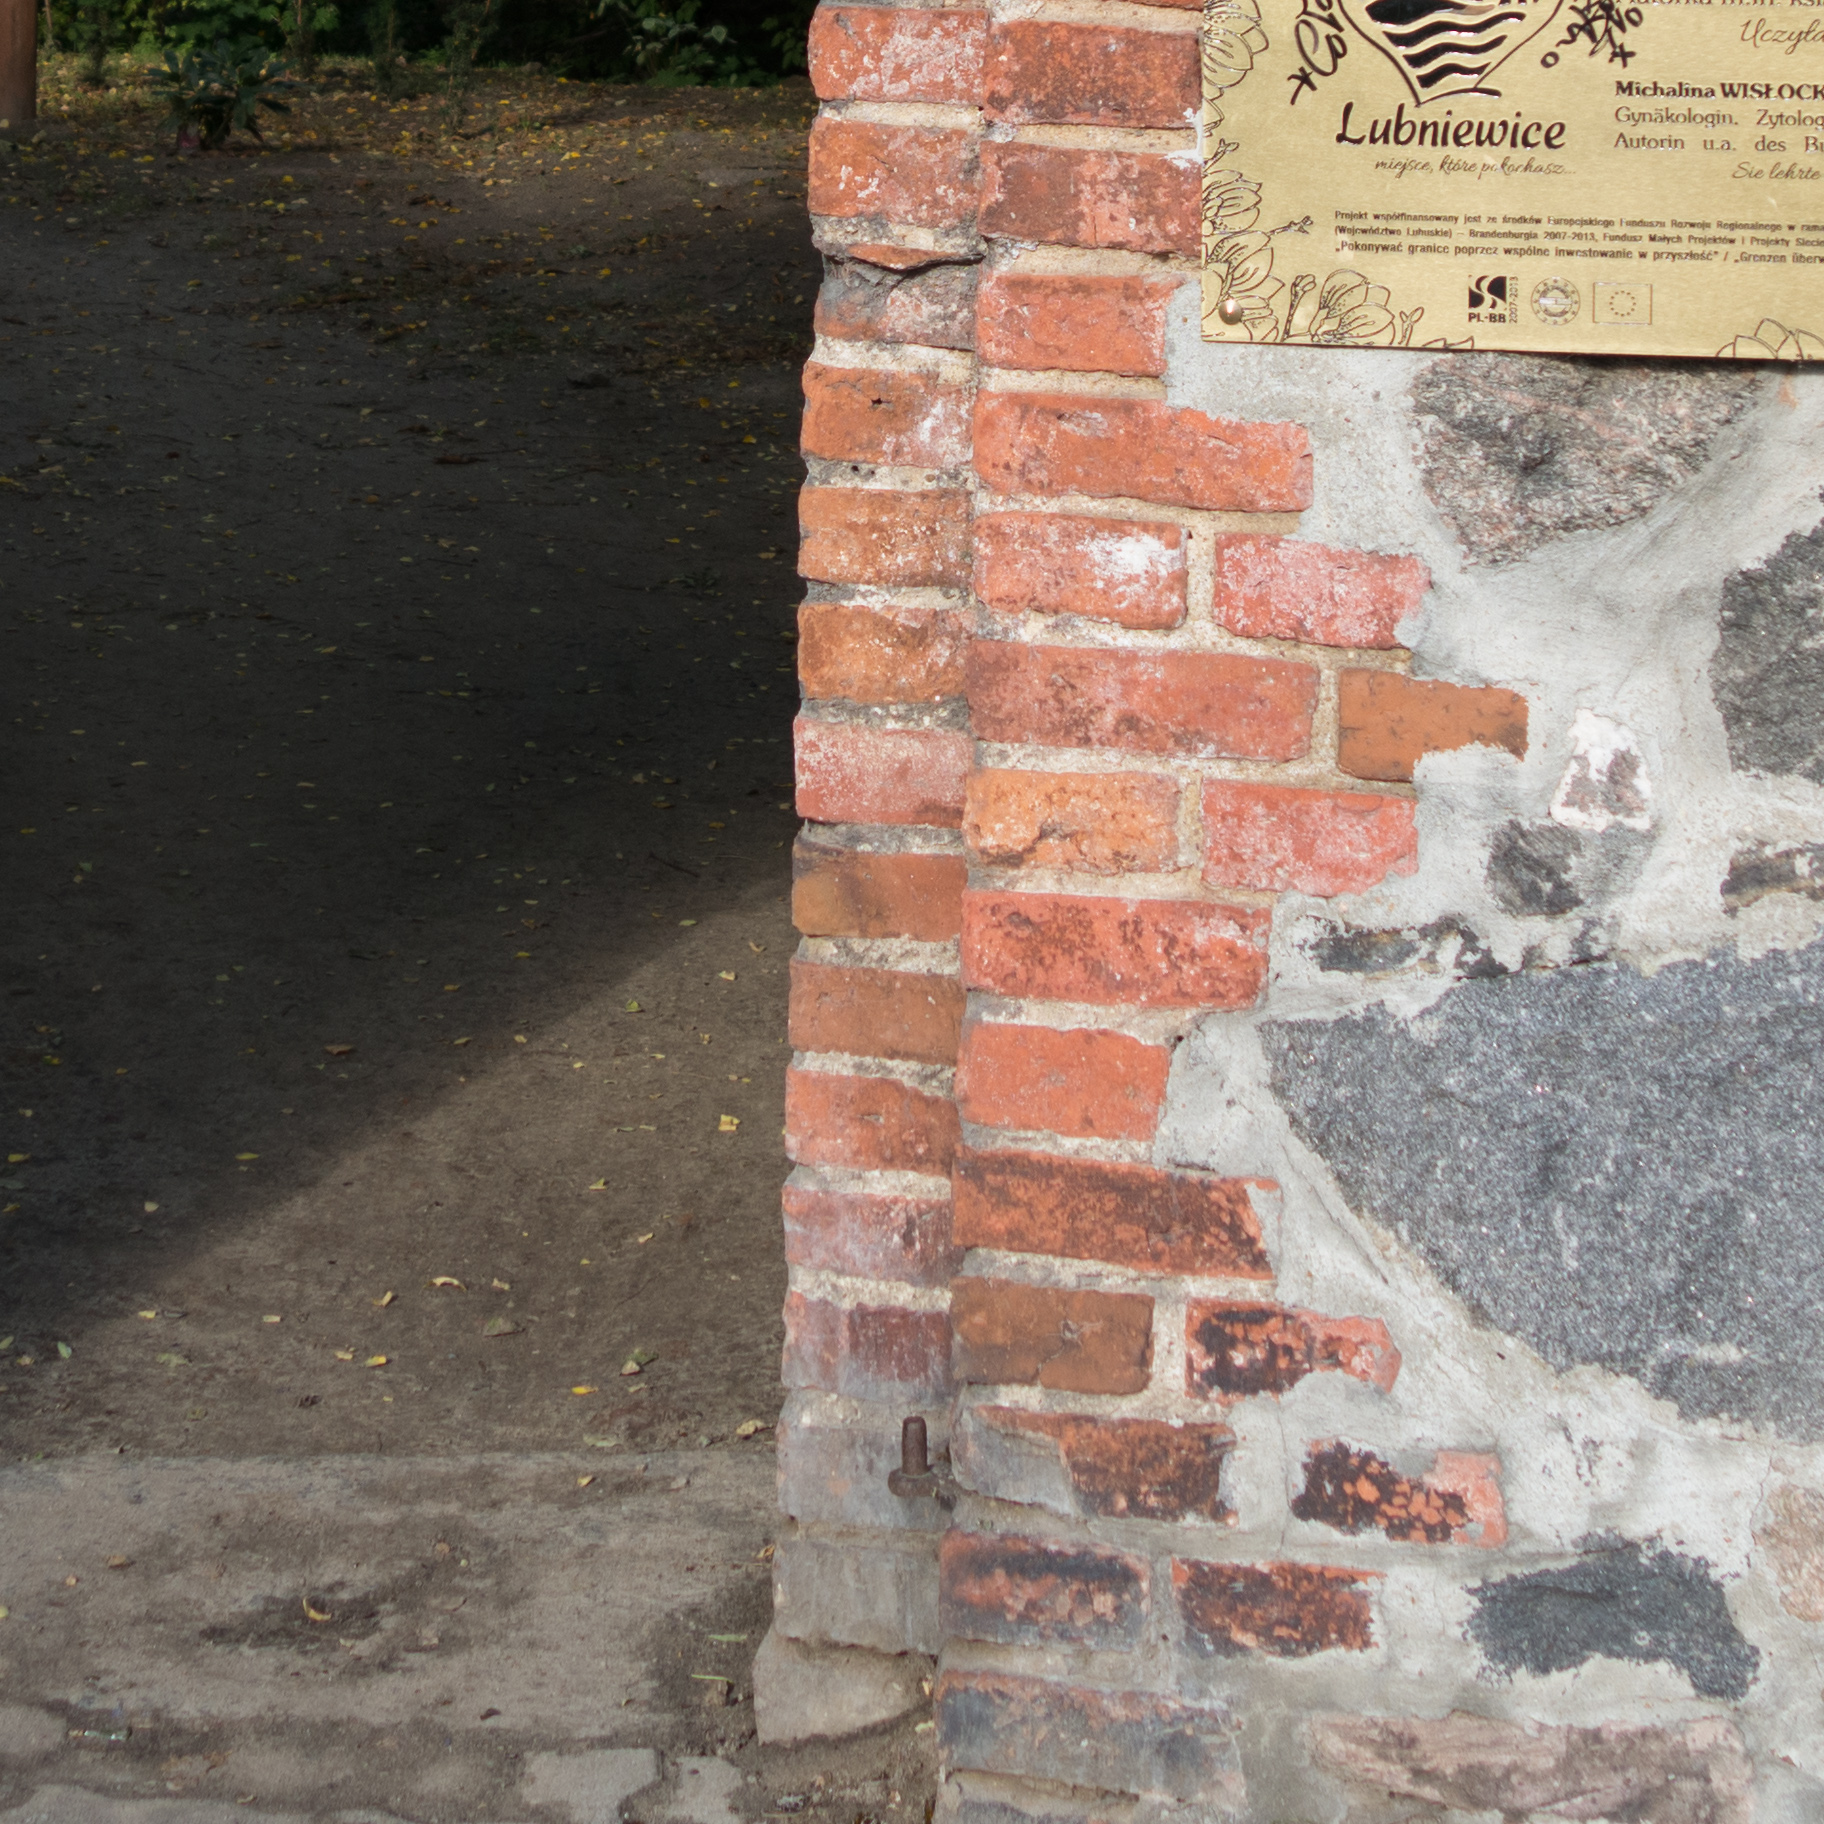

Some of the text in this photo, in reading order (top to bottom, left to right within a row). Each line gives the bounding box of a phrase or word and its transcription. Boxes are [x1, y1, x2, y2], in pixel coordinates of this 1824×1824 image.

[1615, 81, 1715, 98] Michalina
[1336, 97, 1565, 149] Lubniewice
[1731, 162, 1764, 179] Sie
[1769, 162, 1821, 180] lehrte
[1509, 276, 1518, 324] 2007-2013
[1467, 312, 1507, 324] PL-BB
